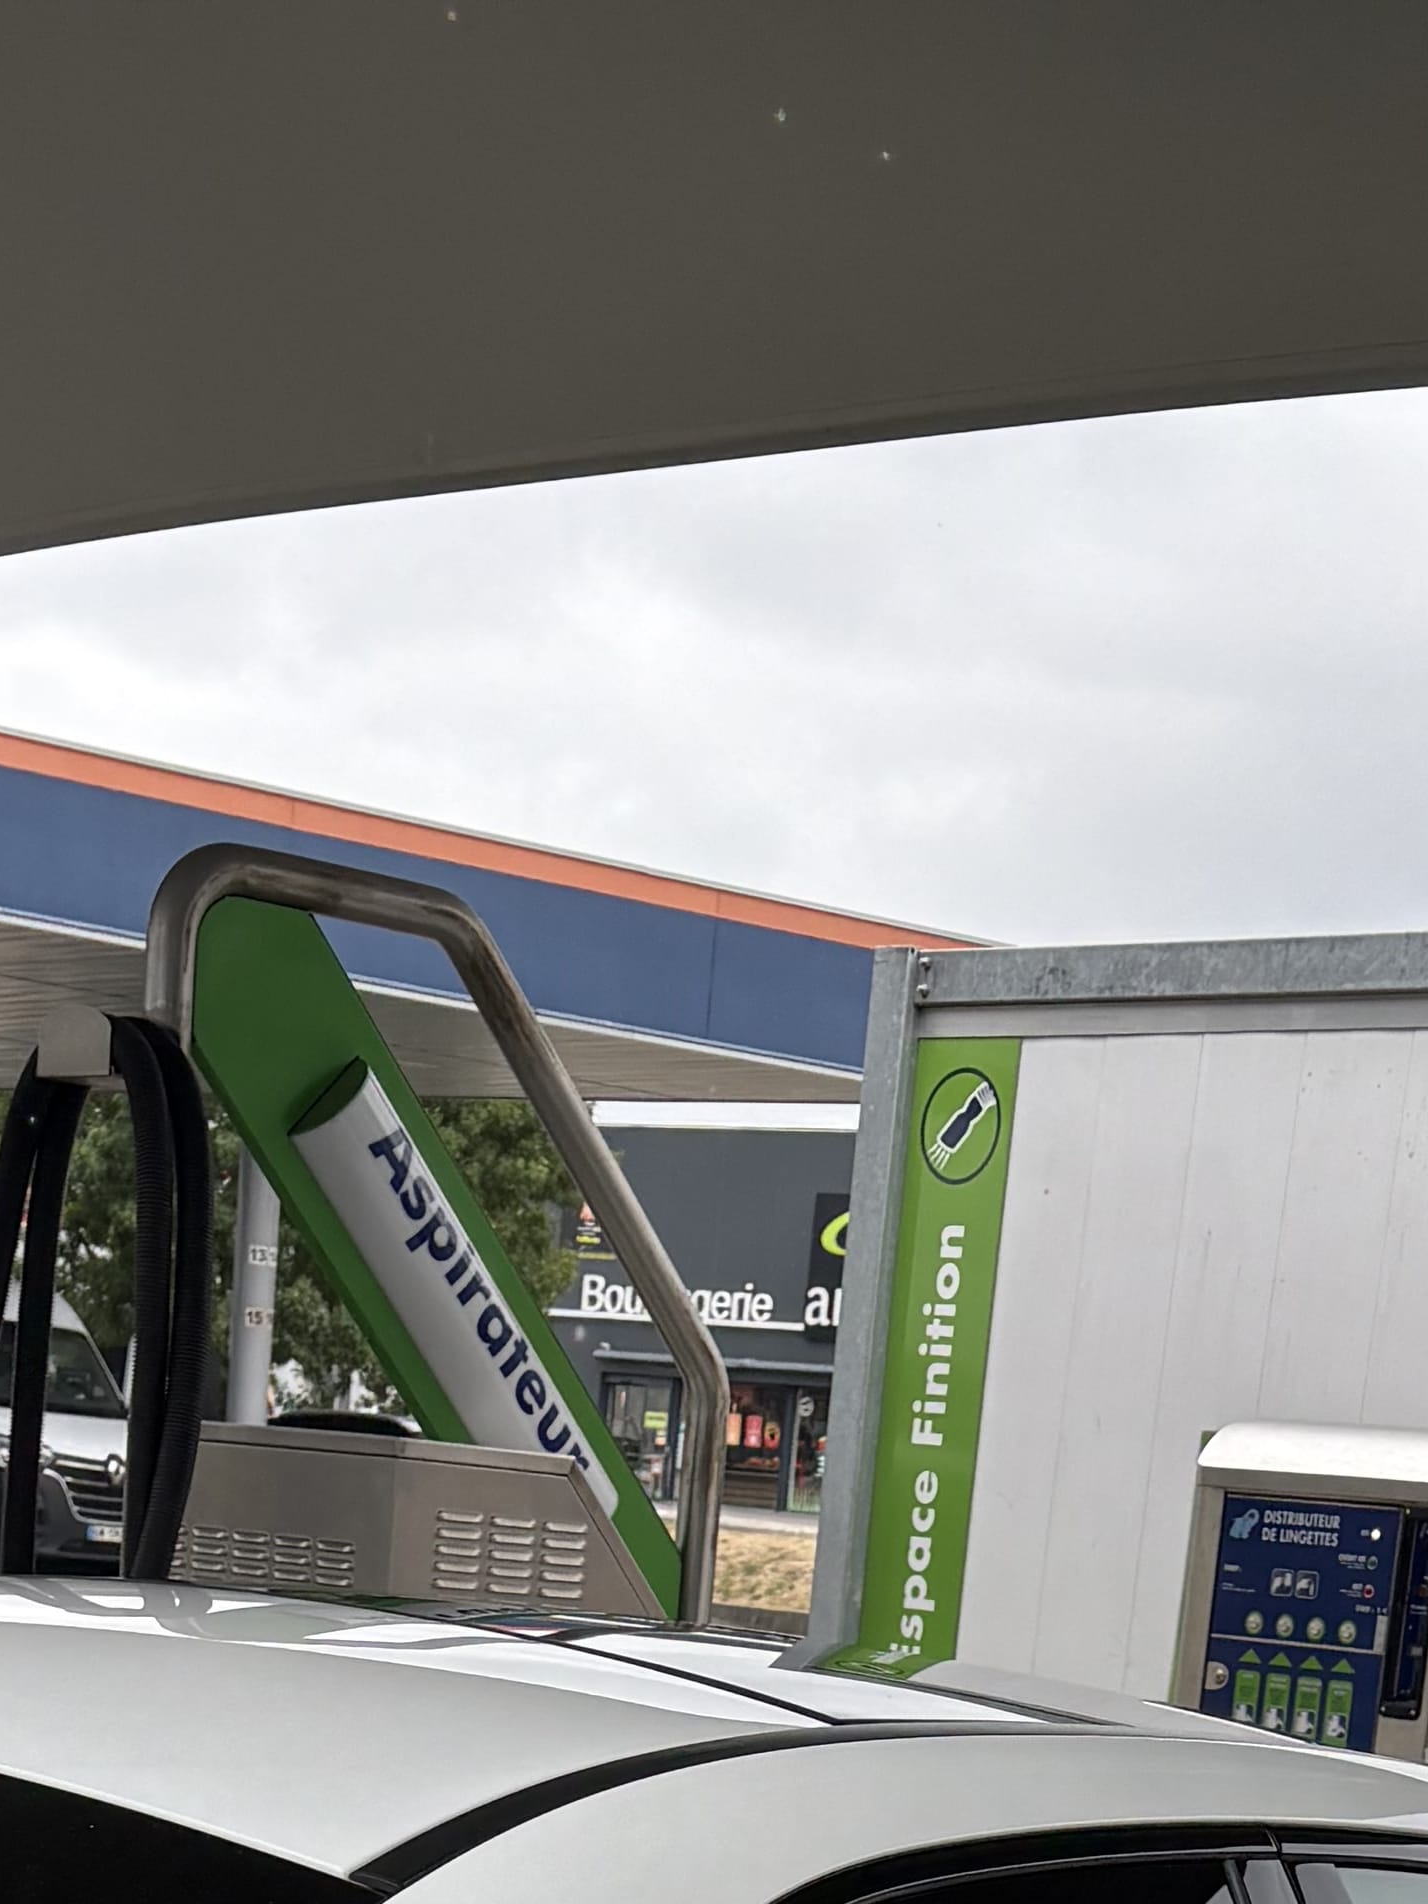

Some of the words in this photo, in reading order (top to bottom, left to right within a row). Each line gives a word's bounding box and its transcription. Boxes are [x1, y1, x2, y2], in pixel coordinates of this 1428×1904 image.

[580, 1273, 774, 1322] Bougerie
[910, 1224, 966, 1447] Finition
[1261, 1527, 1276, 1542] DE
[1279, 1529, 1339, 1547] LINGETTES
[1263, 1509, 1341, 1530] DISTRIBUTEUR
